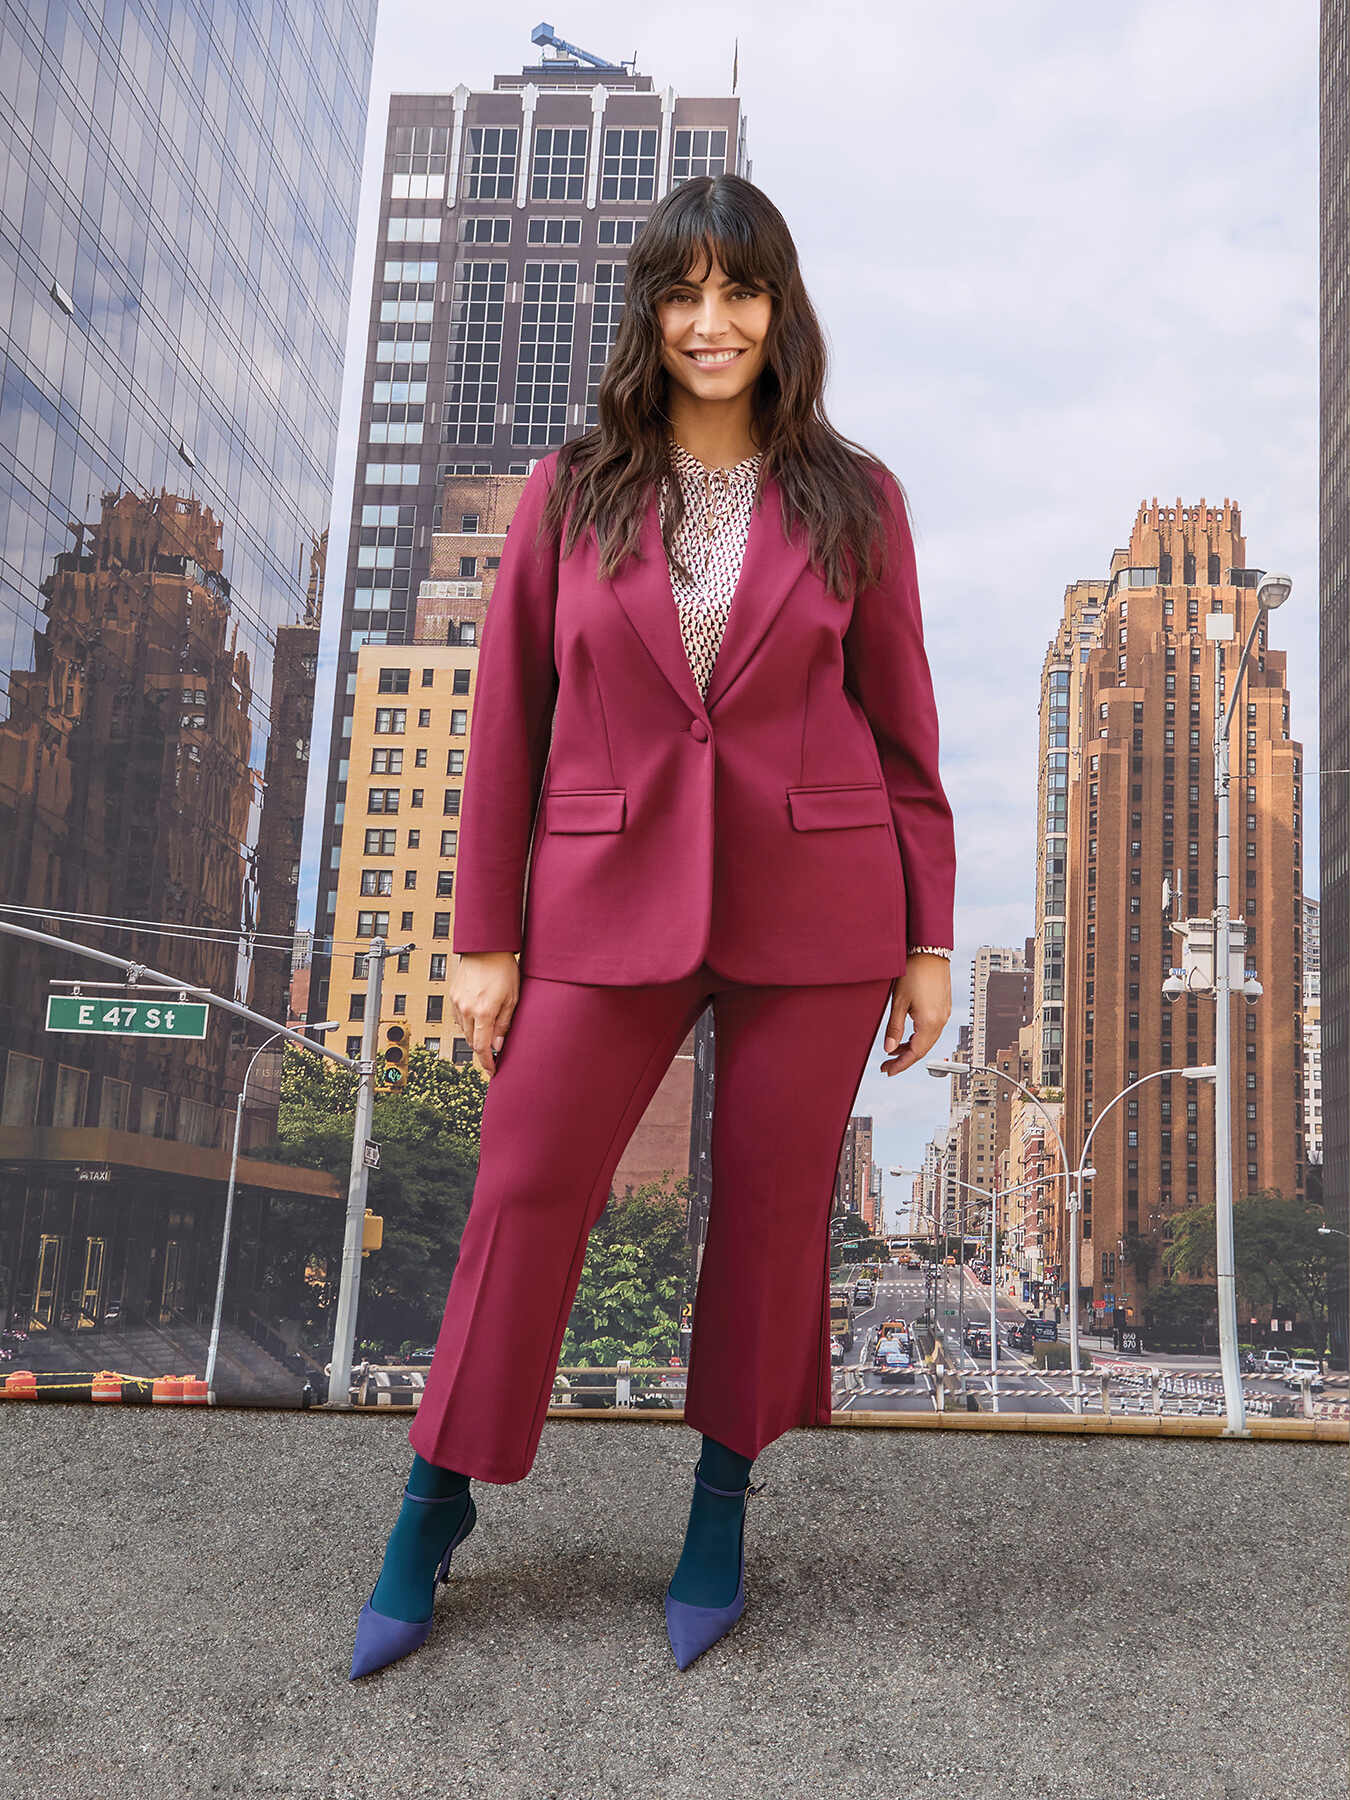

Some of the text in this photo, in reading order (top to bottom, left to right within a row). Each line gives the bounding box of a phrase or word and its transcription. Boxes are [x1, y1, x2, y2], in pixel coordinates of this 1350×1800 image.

[78, 1005, 176, 1030] E 47 St
[90, 1171, 108, 1181] TAXI
[1122, 1340, 1136, 1349] 870
